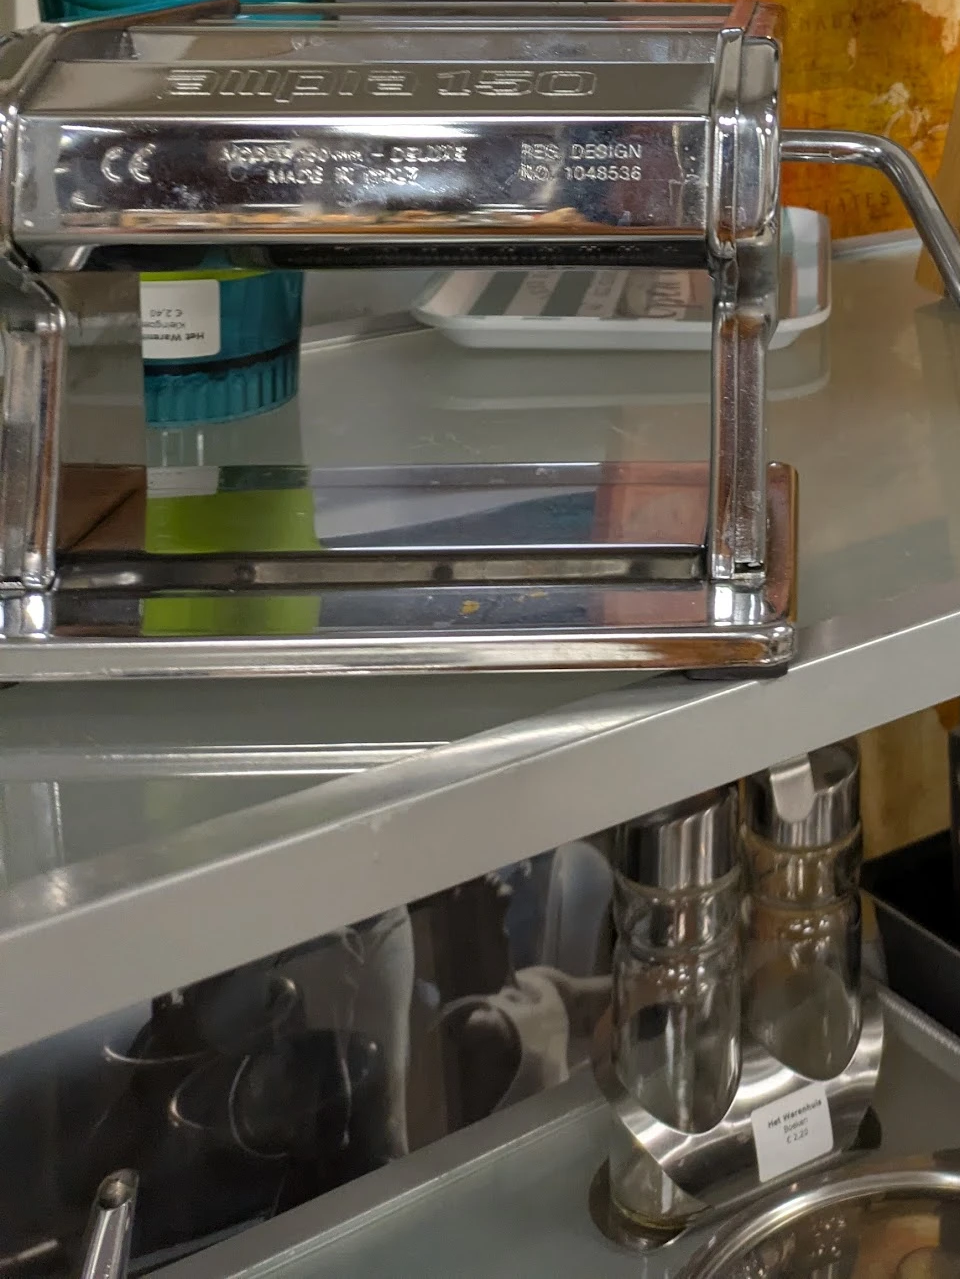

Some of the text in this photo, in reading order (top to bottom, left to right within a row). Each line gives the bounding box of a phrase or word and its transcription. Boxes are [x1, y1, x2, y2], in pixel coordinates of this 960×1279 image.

[437, 69, 598, 97] 150
[569, 143, 642, 159] DESIGN
[267, 167, 323, 184] MADE
[335, 167, 354, 185] IN
[564, 165, 642, 181] 1048536
[185, 332, 205, 341] Het
[768, 1117, 781, 1129] Het
